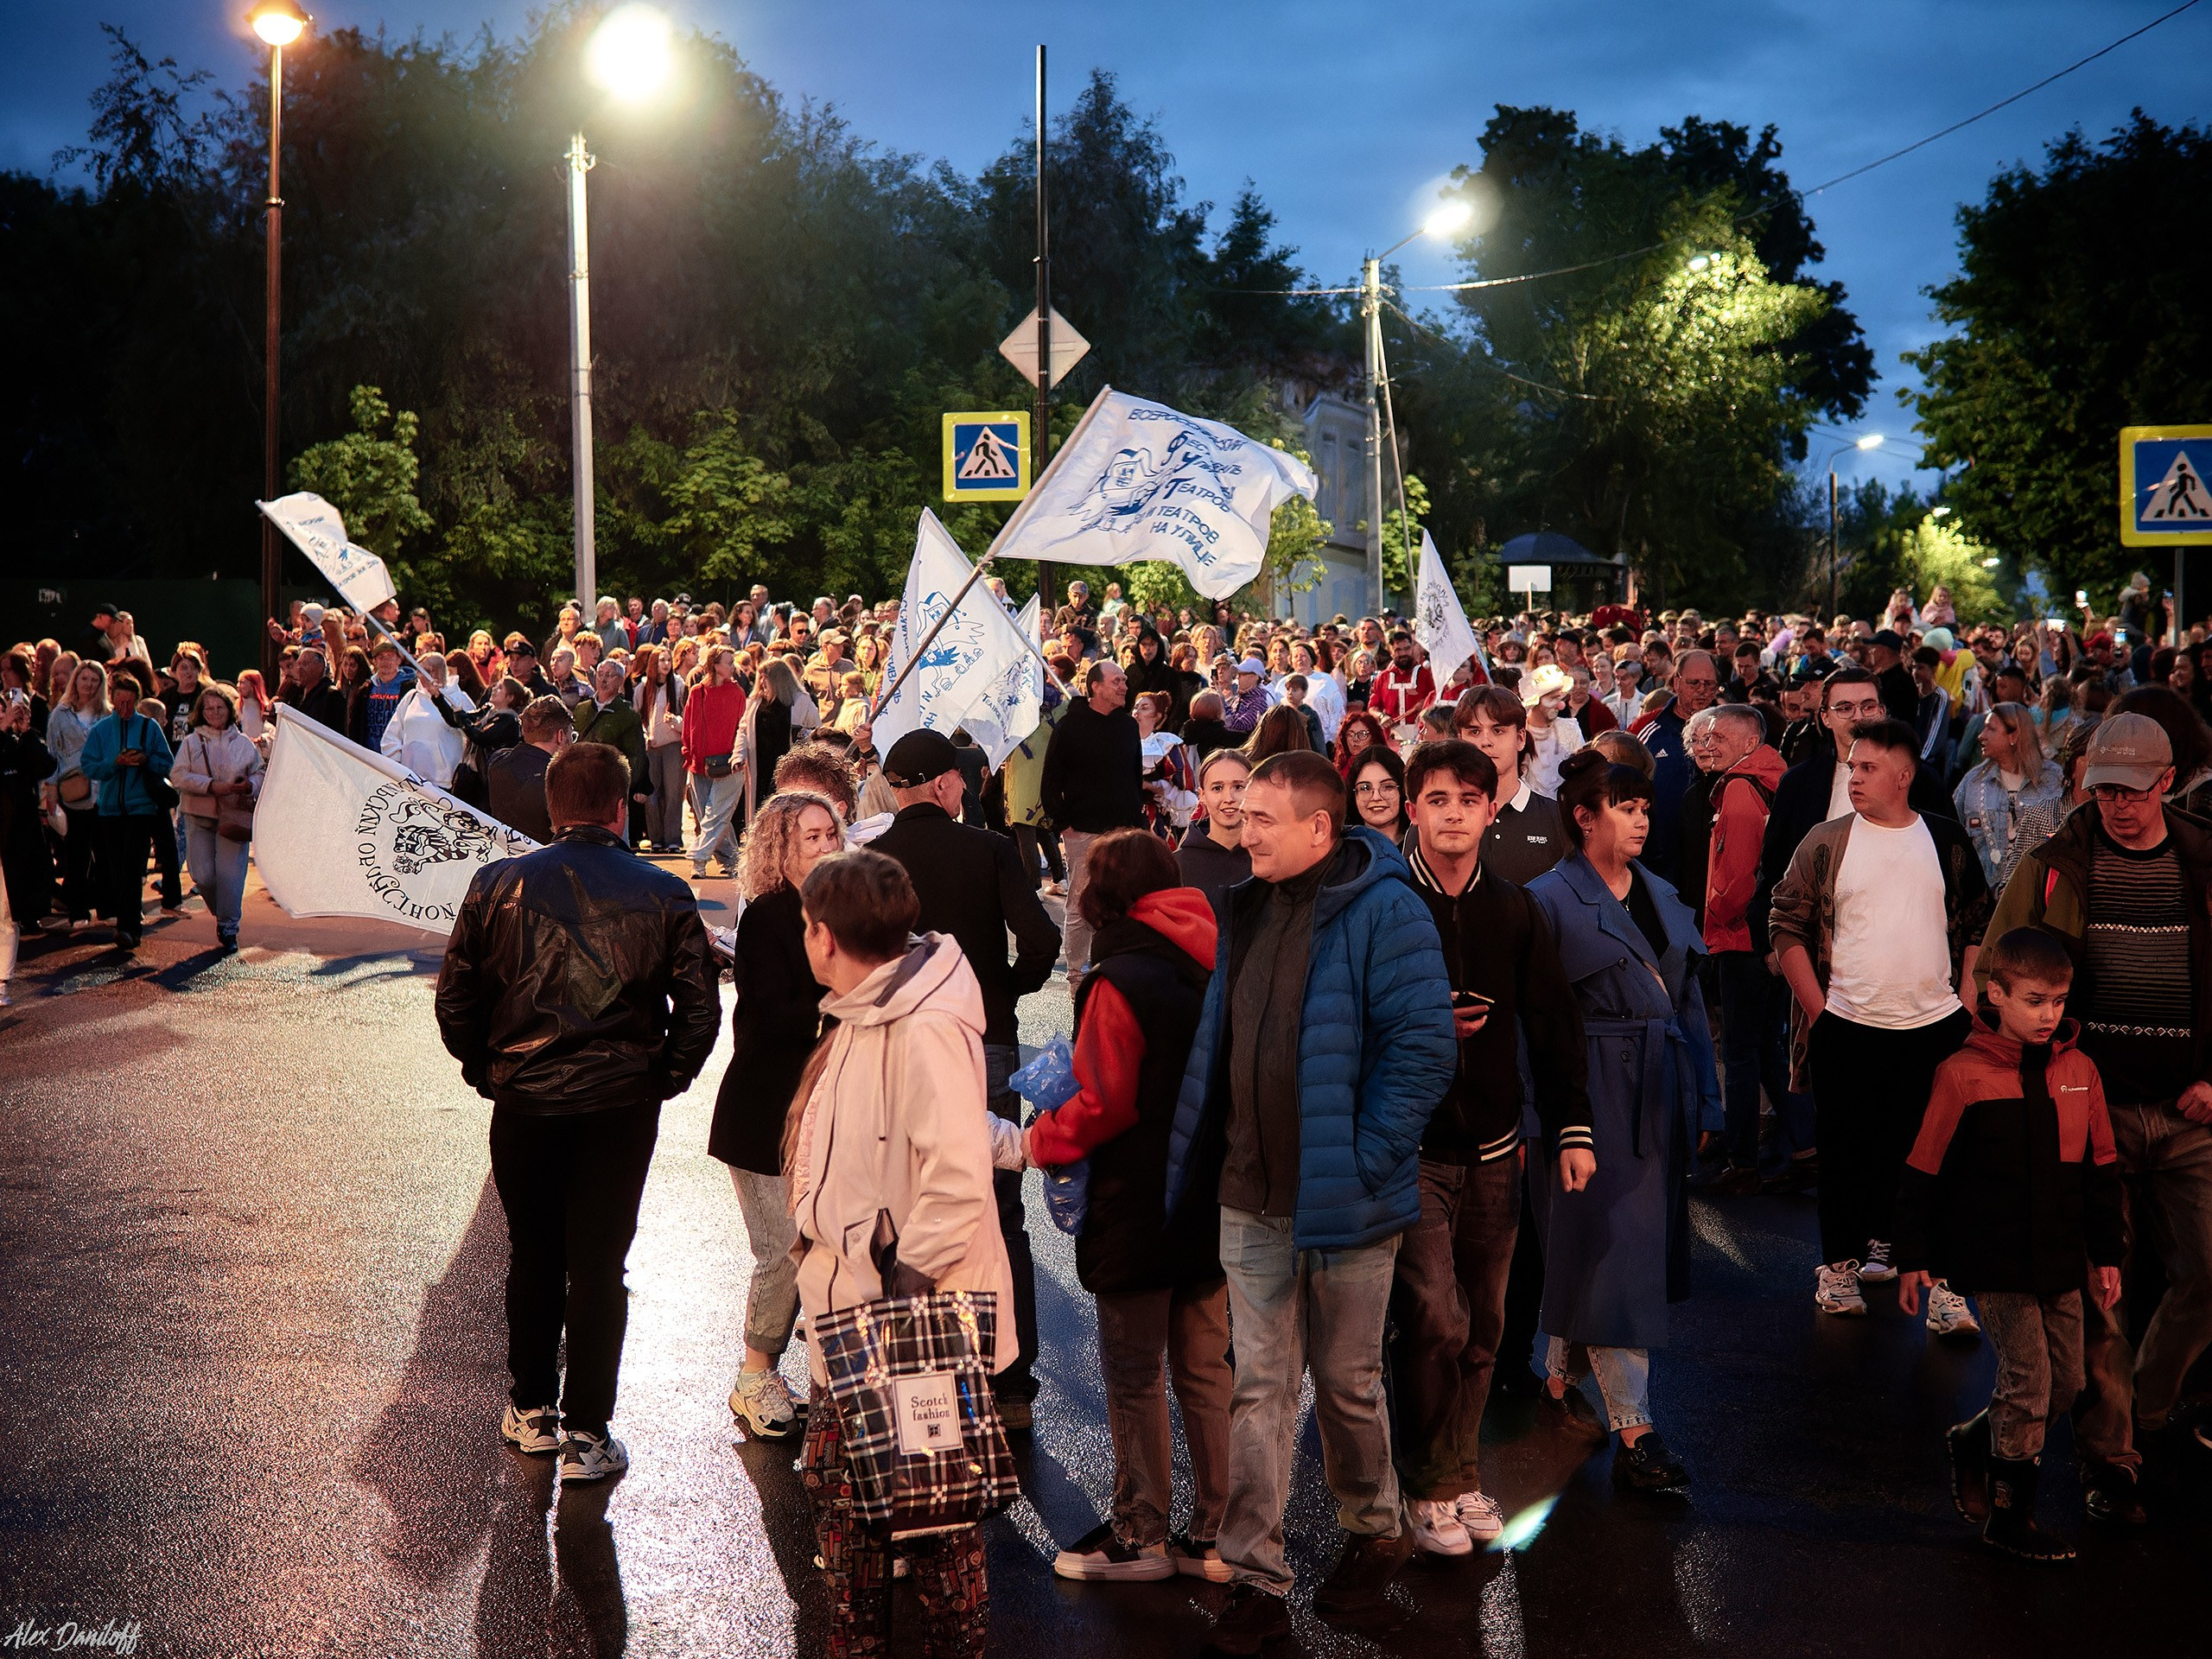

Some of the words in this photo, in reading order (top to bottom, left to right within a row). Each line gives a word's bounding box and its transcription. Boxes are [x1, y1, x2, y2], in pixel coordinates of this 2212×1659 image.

[1149, 521, 1168, 534] НА
[1157, 505, 1219, 543] ТЕАТРОВ
[912, 1408, 950, 1421] fashion
